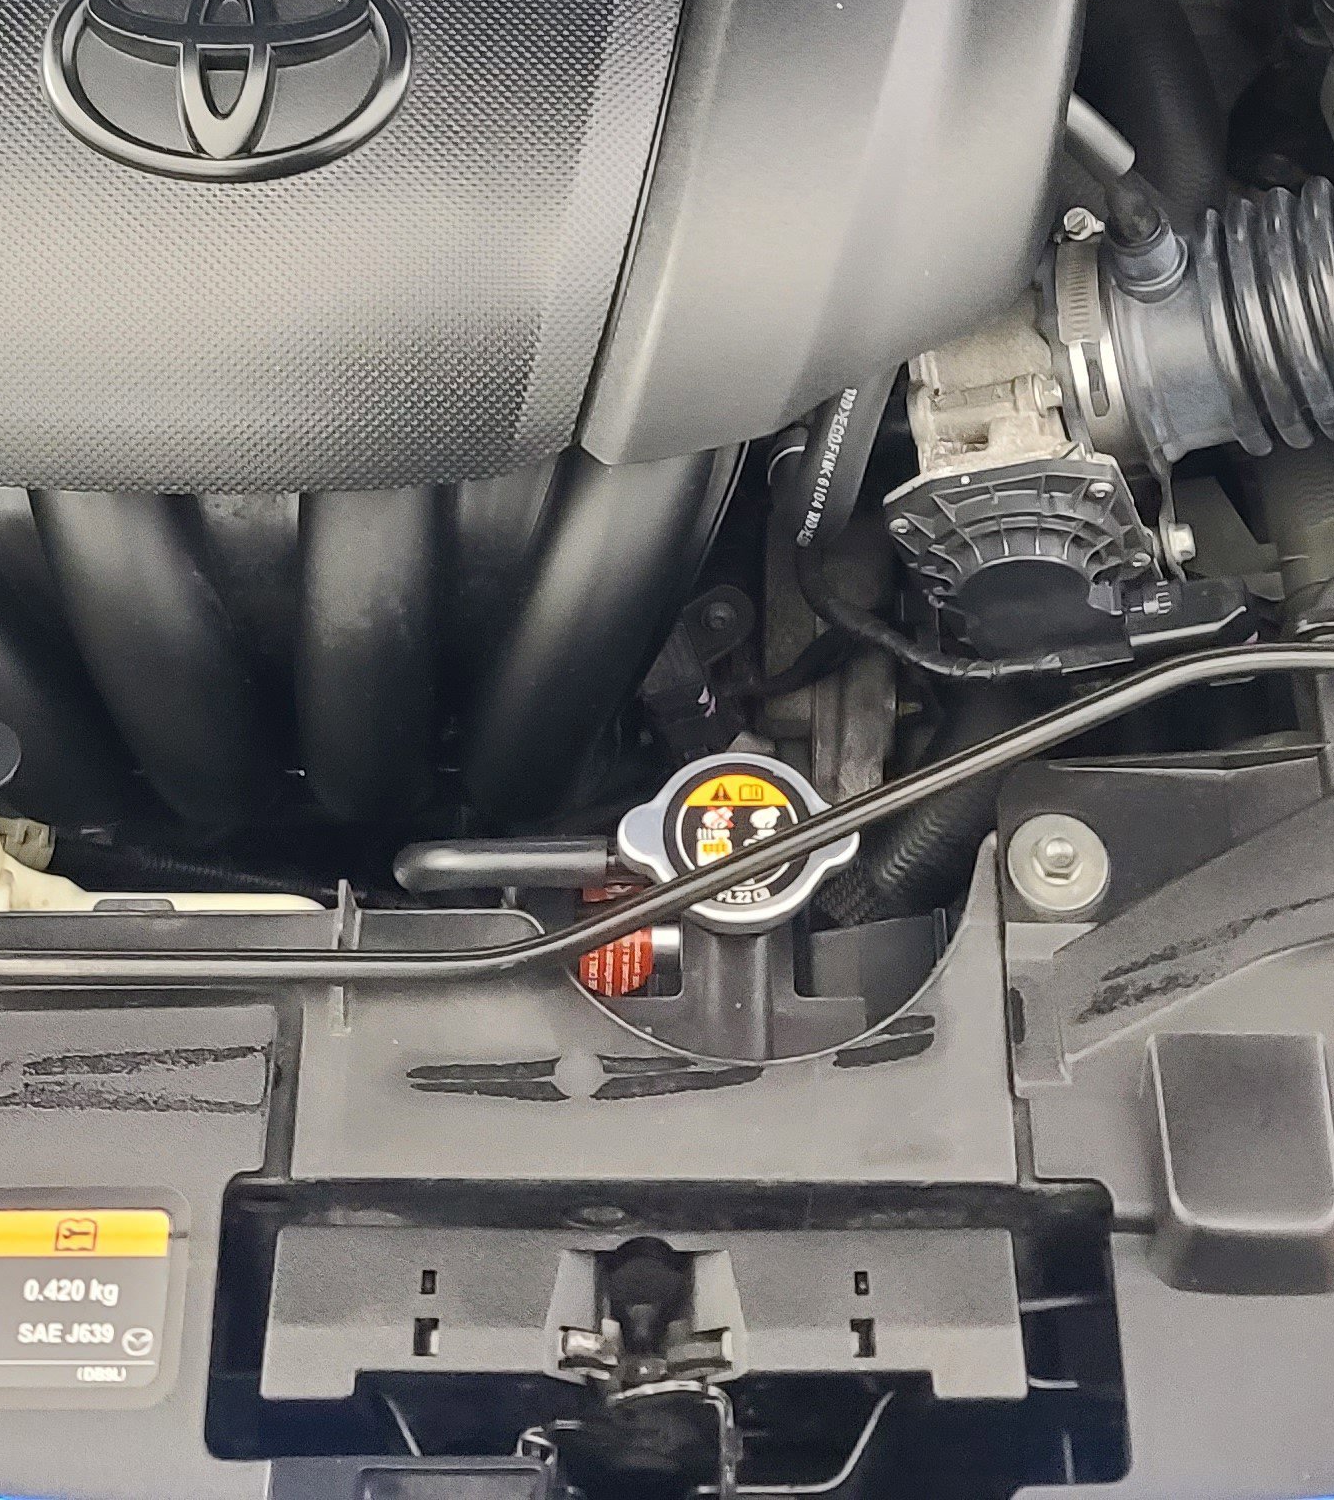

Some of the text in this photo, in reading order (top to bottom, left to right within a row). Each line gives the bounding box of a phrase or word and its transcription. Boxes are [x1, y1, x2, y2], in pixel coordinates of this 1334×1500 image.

[23, 1279, 85, 1302] 0.420
[89, 1279, 119, 1307] kg
[17, 1322, 64, 1344] SAE
[65, 1323, 115, 1345] J639
